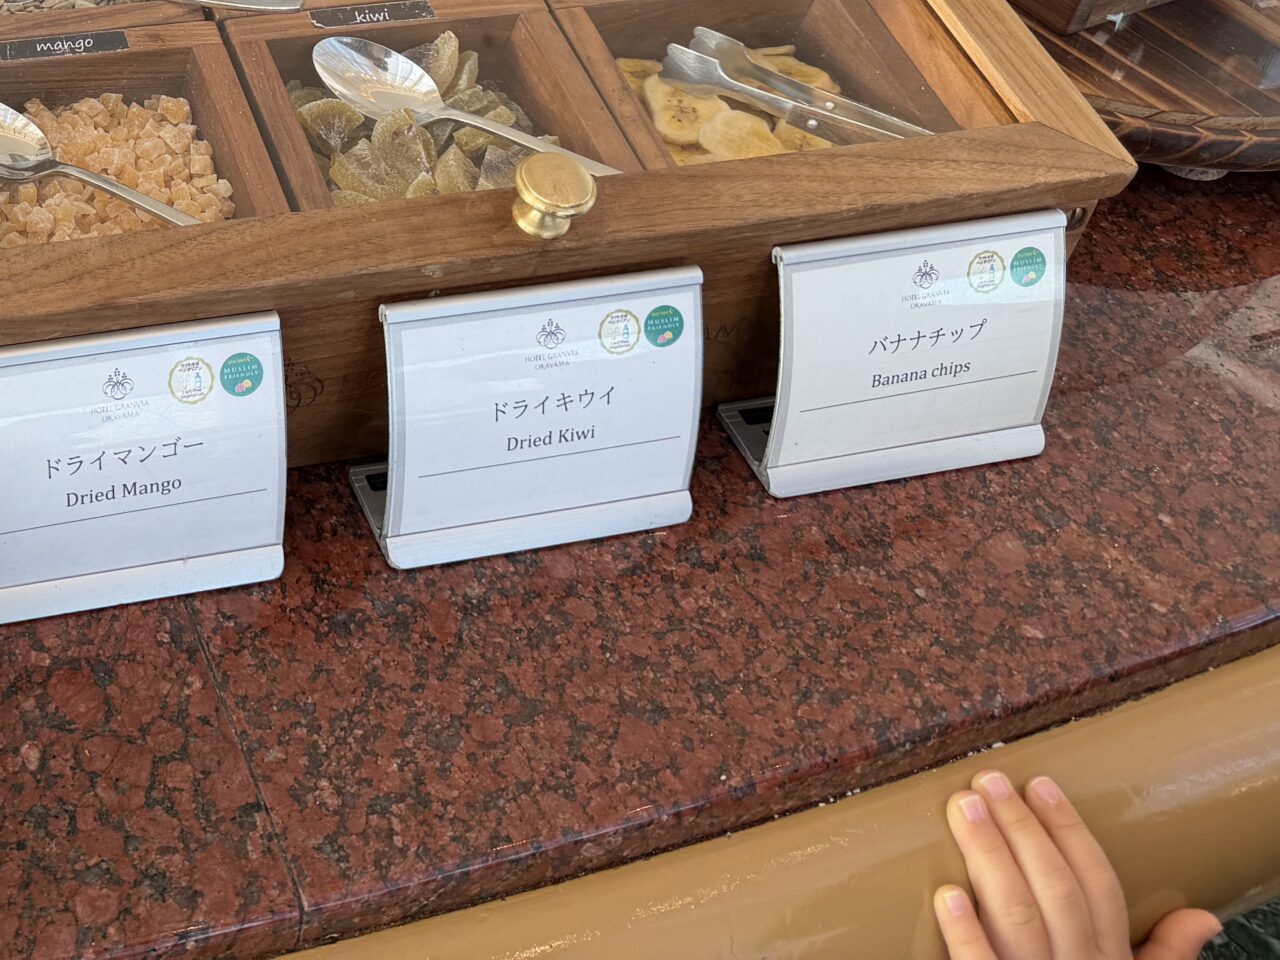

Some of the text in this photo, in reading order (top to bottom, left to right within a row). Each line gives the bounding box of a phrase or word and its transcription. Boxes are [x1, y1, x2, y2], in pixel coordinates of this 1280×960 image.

[354, 7, 389, 23] kiwi
[36, 35, 94, 54] mango
[868, 317, 988, 356] バナナチップ
[871, 360, 971, 388] Banana chips
[494, 386, 615, 422] ドライキウイ
[506, 425, 596, 452] Dried Kiwi
[46, 435, 204, 480] ドライマンゴー
[66, 478, 183, 508] Dried Mango
